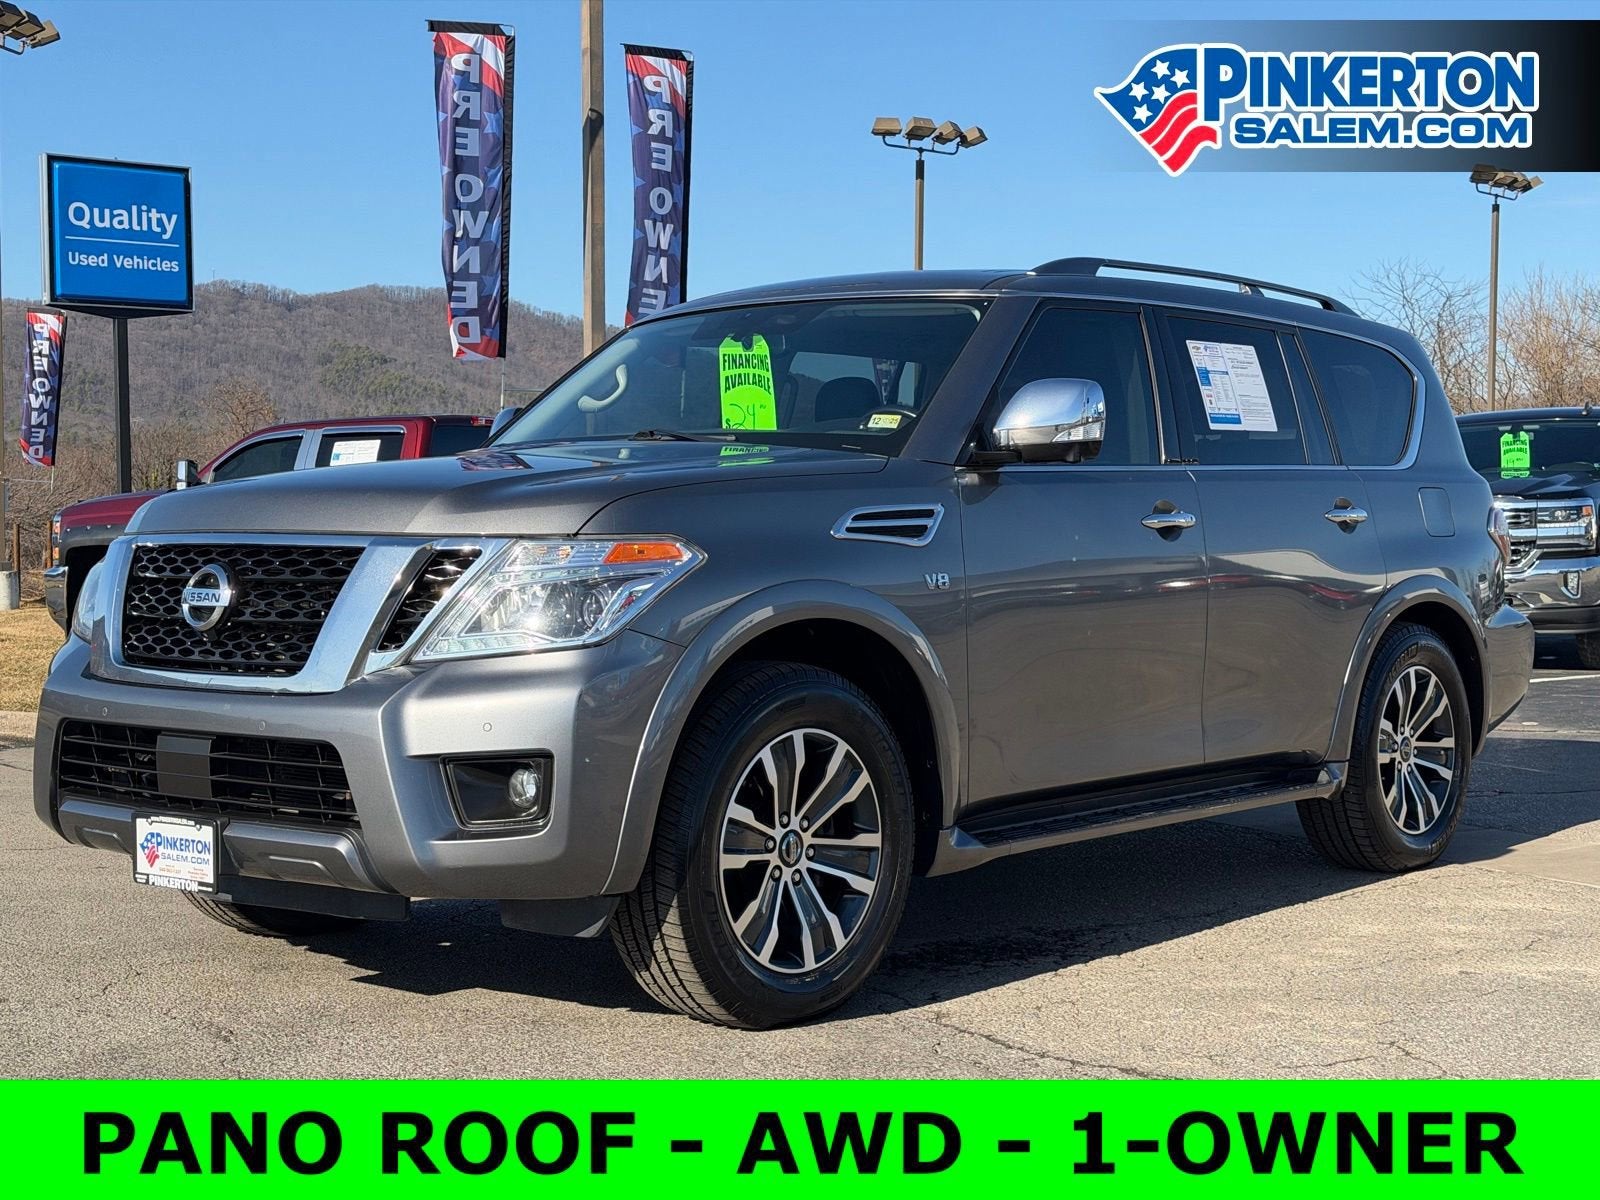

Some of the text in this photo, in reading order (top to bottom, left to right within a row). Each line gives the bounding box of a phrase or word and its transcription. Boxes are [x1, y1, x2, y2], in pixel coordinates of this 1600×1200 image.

[67, 201, 178, 240] Quality
[68, 251, 179, 272] Used Vehicles
[722, 353, 770, 373] FINANCING
[724, 373, 772, 395] AVAILABLE
[924, 572, 950, 590] V8
[183, 590, 221, 604] NISSAN
[156, 832, 211, 856] PINKERTON
[160, 852, 210, 866] SALEM.COM
[148, 874, 199, 892] PINKERTON
